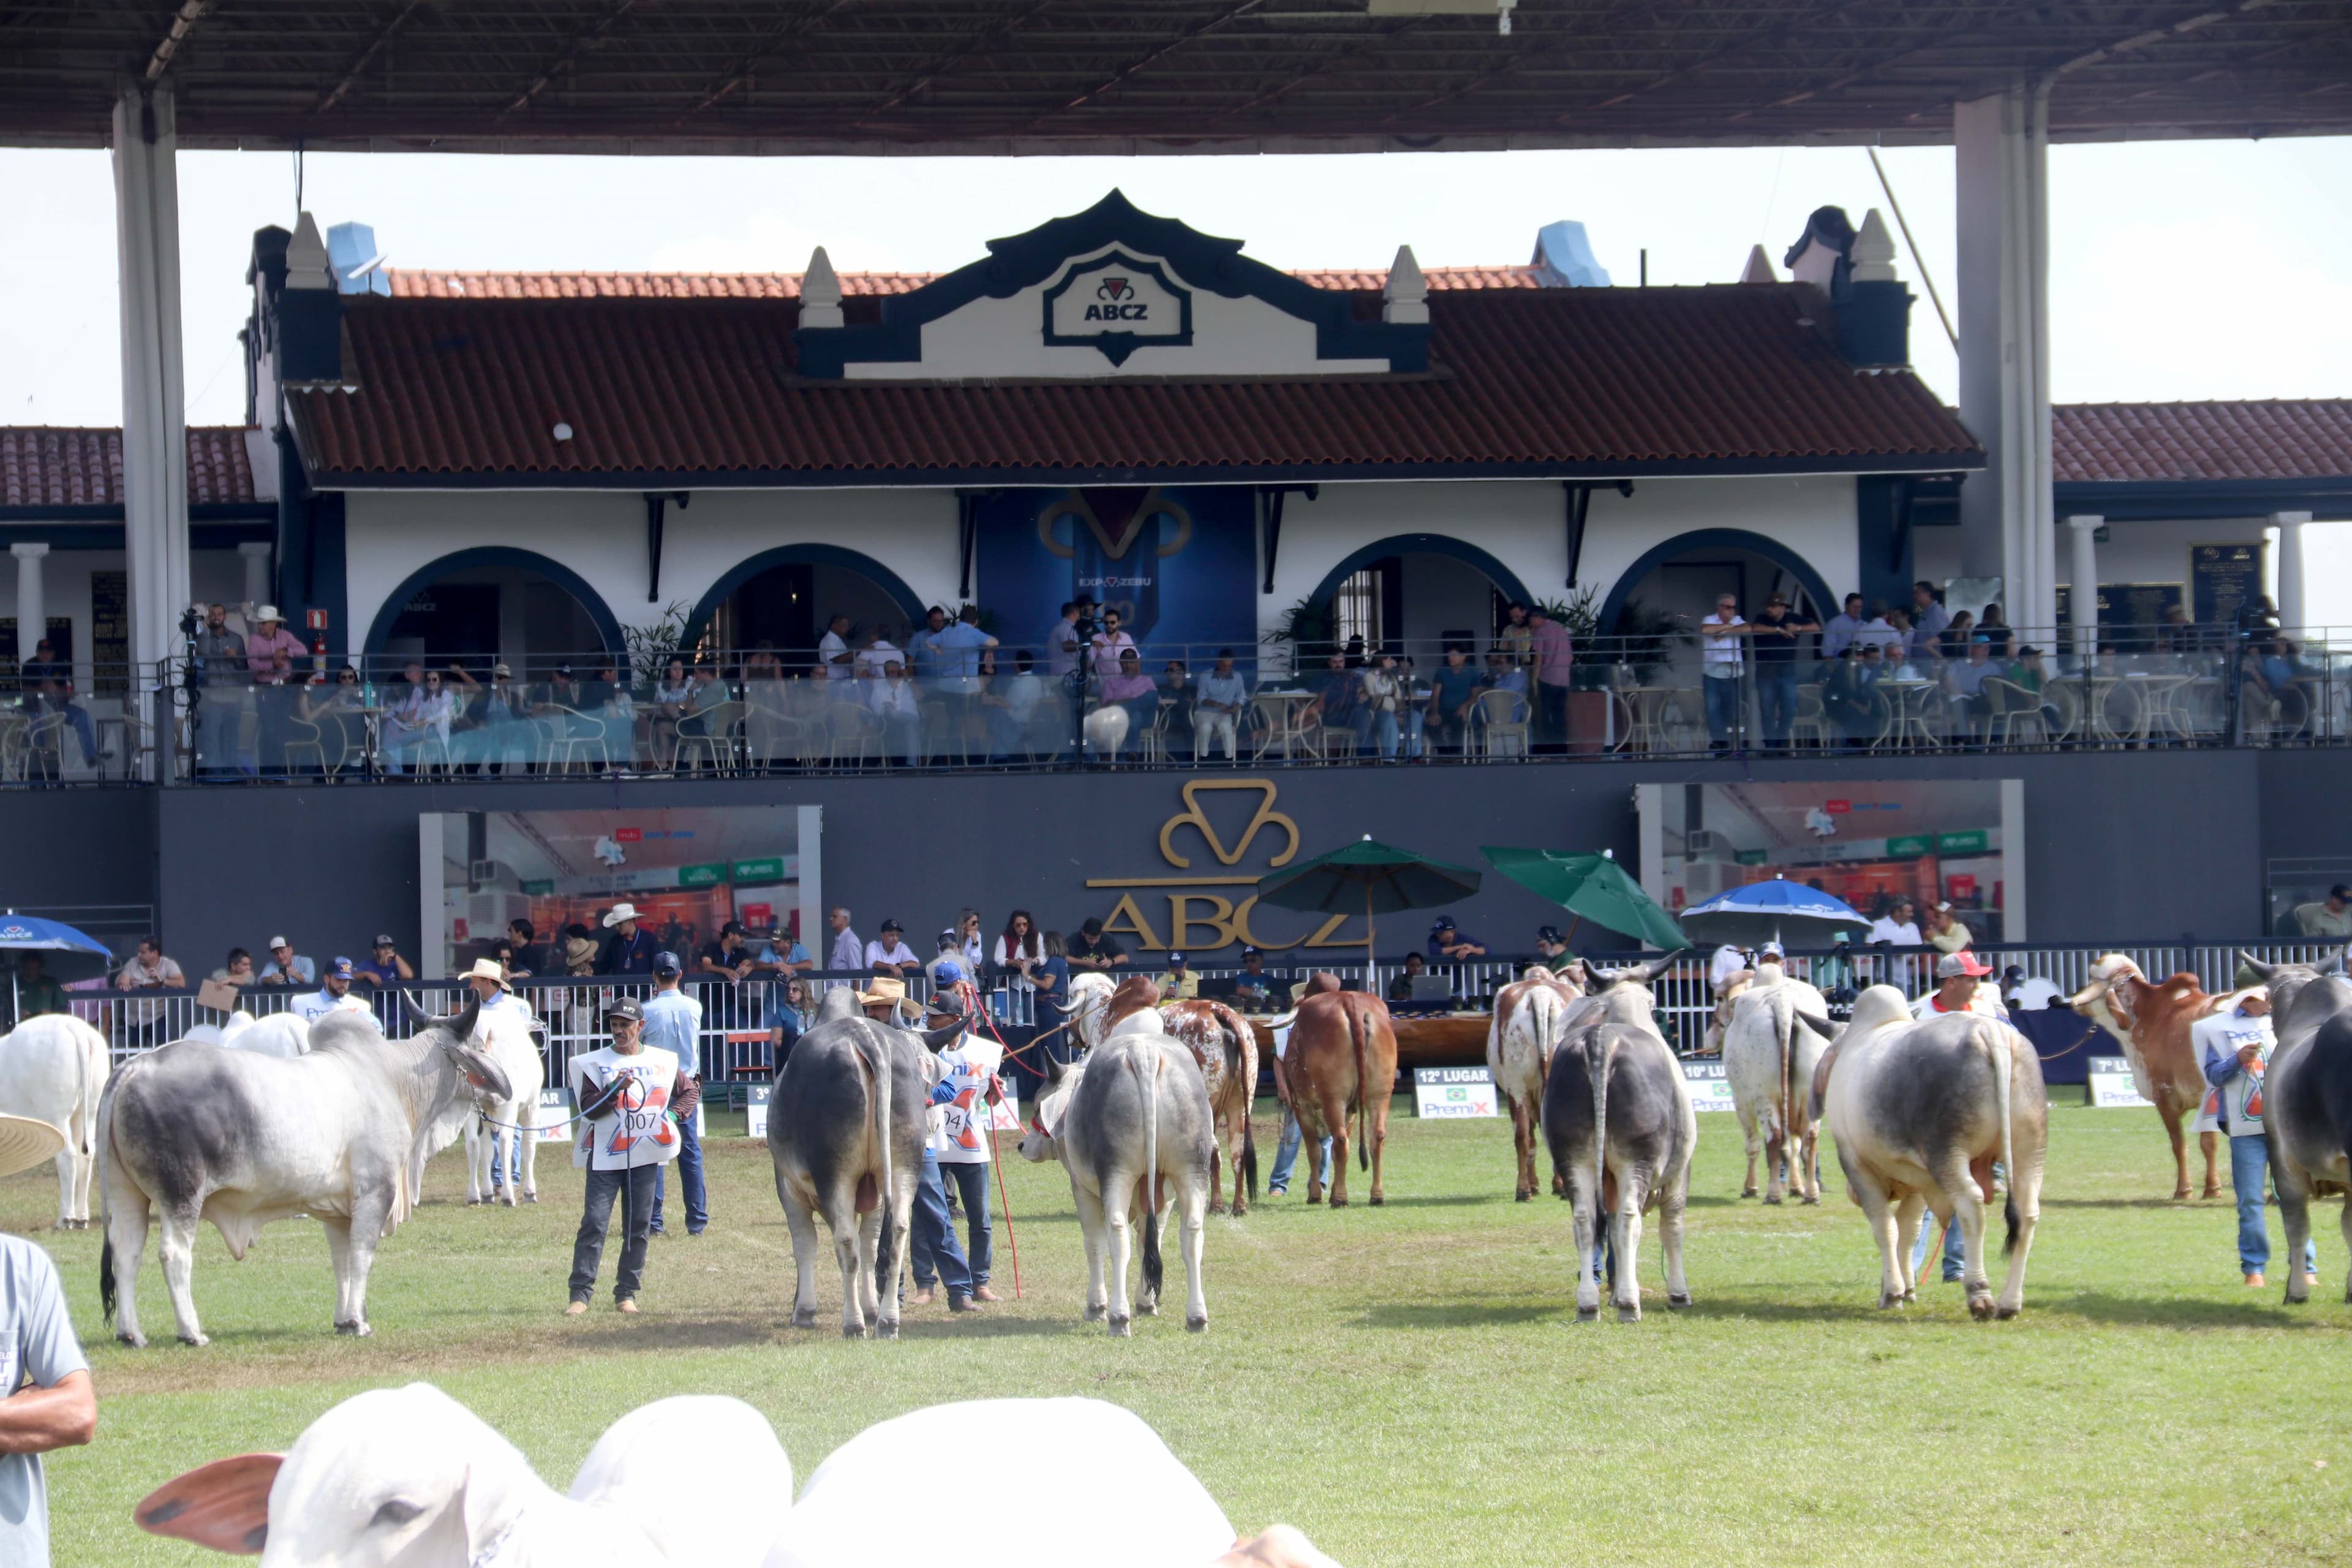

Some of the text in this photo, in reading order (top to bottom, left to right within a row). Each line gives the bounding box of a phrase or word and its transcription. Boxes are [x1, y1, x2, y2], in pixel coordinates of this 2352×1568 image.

[1084, 304, 1148, 321] ABCZ
[1101, 893, 1376, 951] ABCZ
[1443, 1070, 1489, 1082] LUGAR
[1425, 1102, 1490, 1115] PremiX
[625, 1113, 657, 1130] 007
